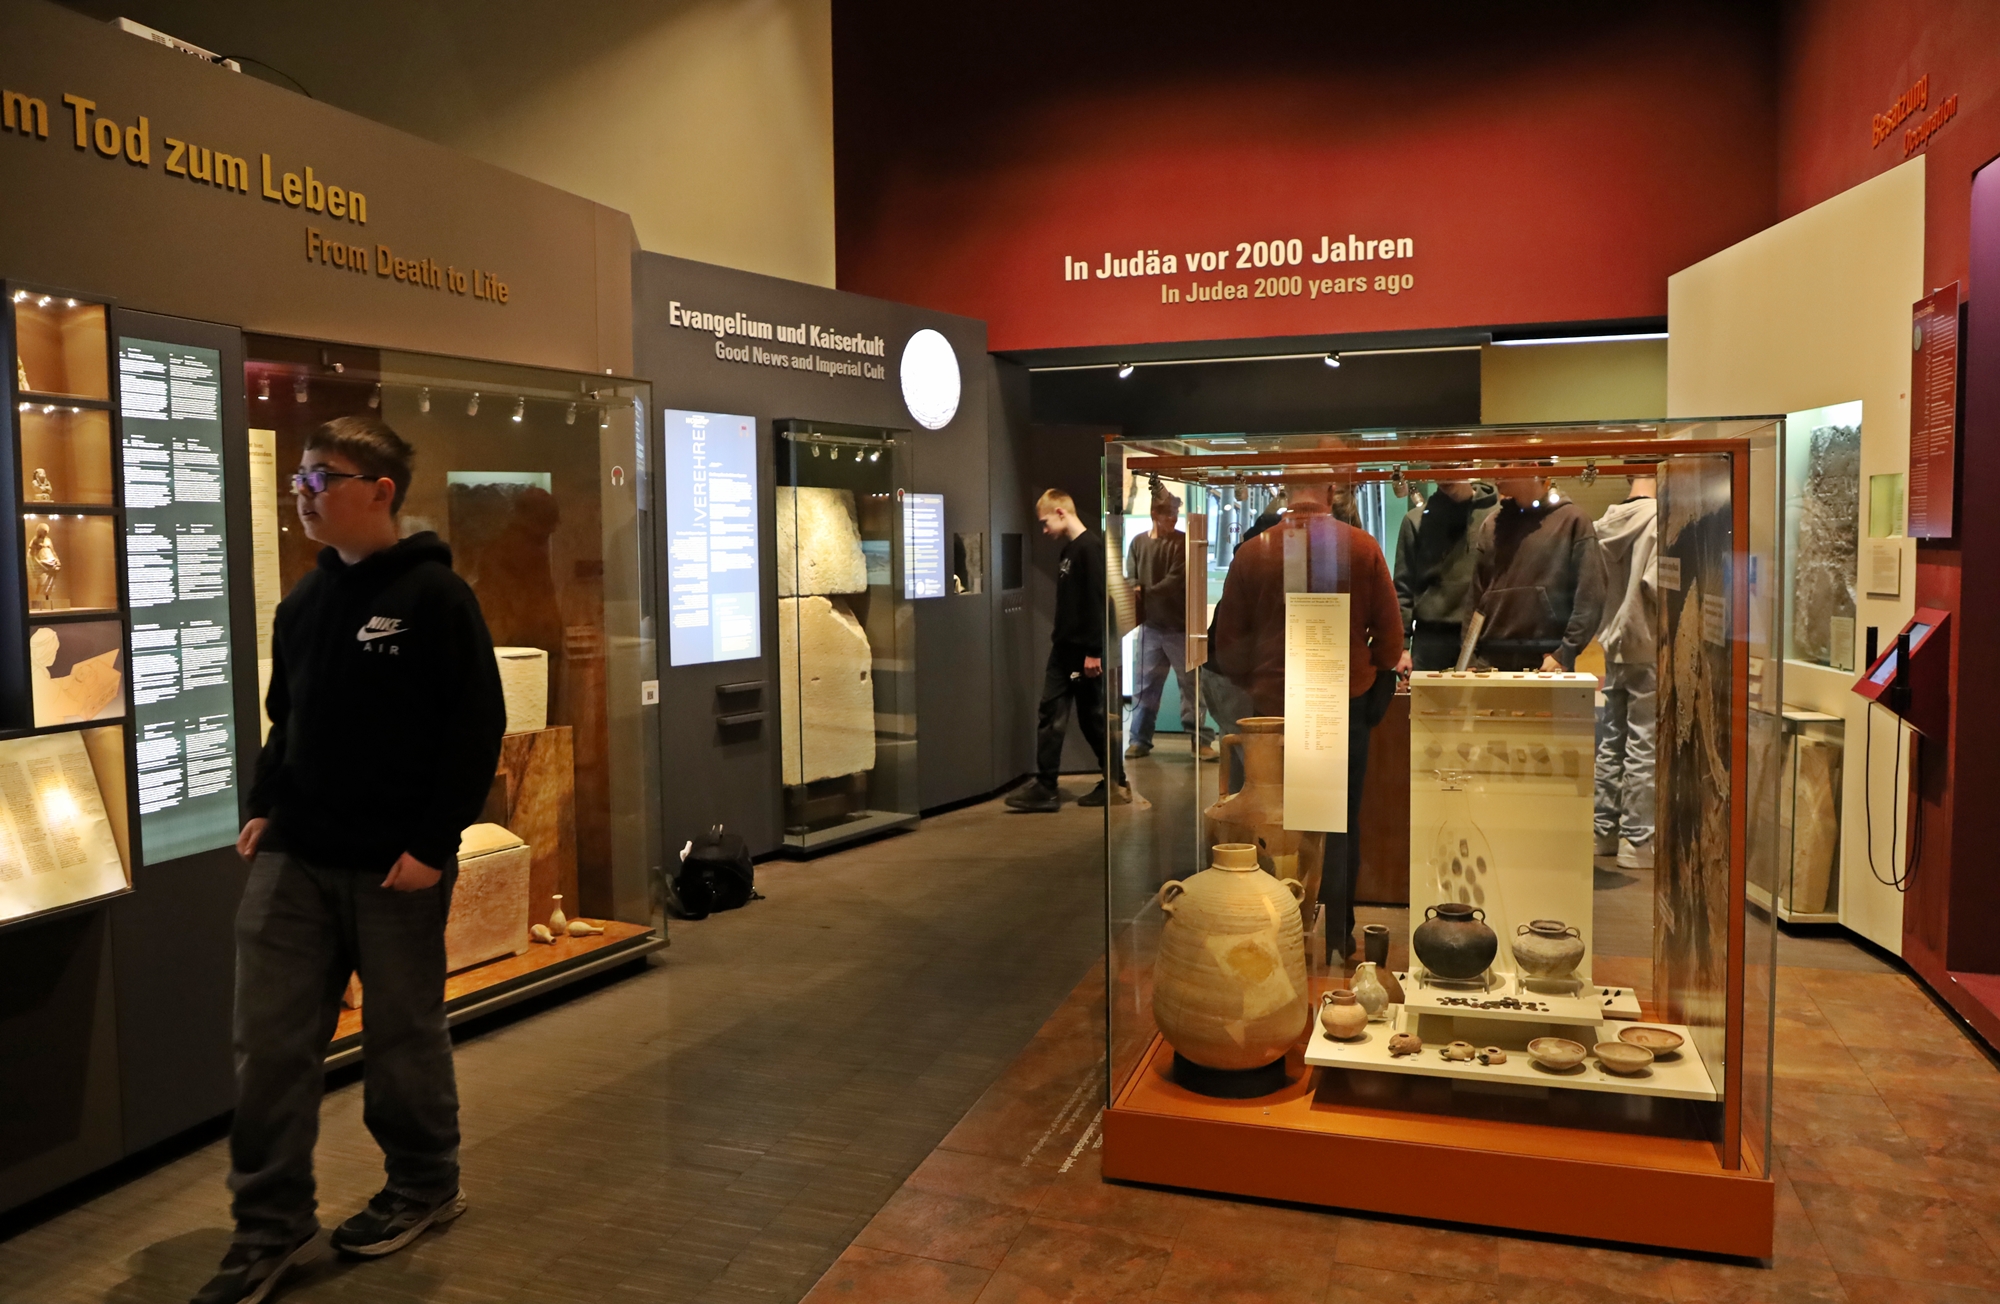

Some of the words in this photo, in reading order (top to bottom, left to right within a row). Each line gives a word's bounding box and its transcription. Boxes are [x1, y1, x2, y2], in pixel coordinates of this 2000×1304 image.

[1872, 73, 1929, 149] Besatzung
[1904, 93, 1958, 158] Occupation
[64, 93, 149, 165] Tod
[165, 137, 248, 191] zum
[261, 153, 367, 223] Leben
[307, 227, 368, 270] From
[376, 245, 442, 288] Death
[447, 265, 468, 293] to
[473, 269, 509, 303] Life
[1065, 256, 1089, 281] In
[1096, 250, 1177, 279] Judäa
[1185, 250, 1229, 272] vor
[1236, 238, 1302, 269] 2000
[1312, 234, 1414, 264] Jahren
[1161, 284, 1180, 303] In
[1186, 280, 1248, 303] Judea
[1254, 276, 1302, 298] 2000
[1308, 272, 1368, 299] years
[1374, 272, 1414, 295] ago
[669, 301, 773, 338] Evangelium
[777, 323, 806, 345] und
[810, 325, 885, 357] Kaiserkult
[715, 340, 749, 363] Good
[753, 346, 789, 367] News
[791, 355, 813, 371] and
[816, 355, 861, 377] Imperial
[864, 362, 885, 380] Cult
[363, 642, 400, 656] AIR
[366, 616, 402, 631] NIKE
